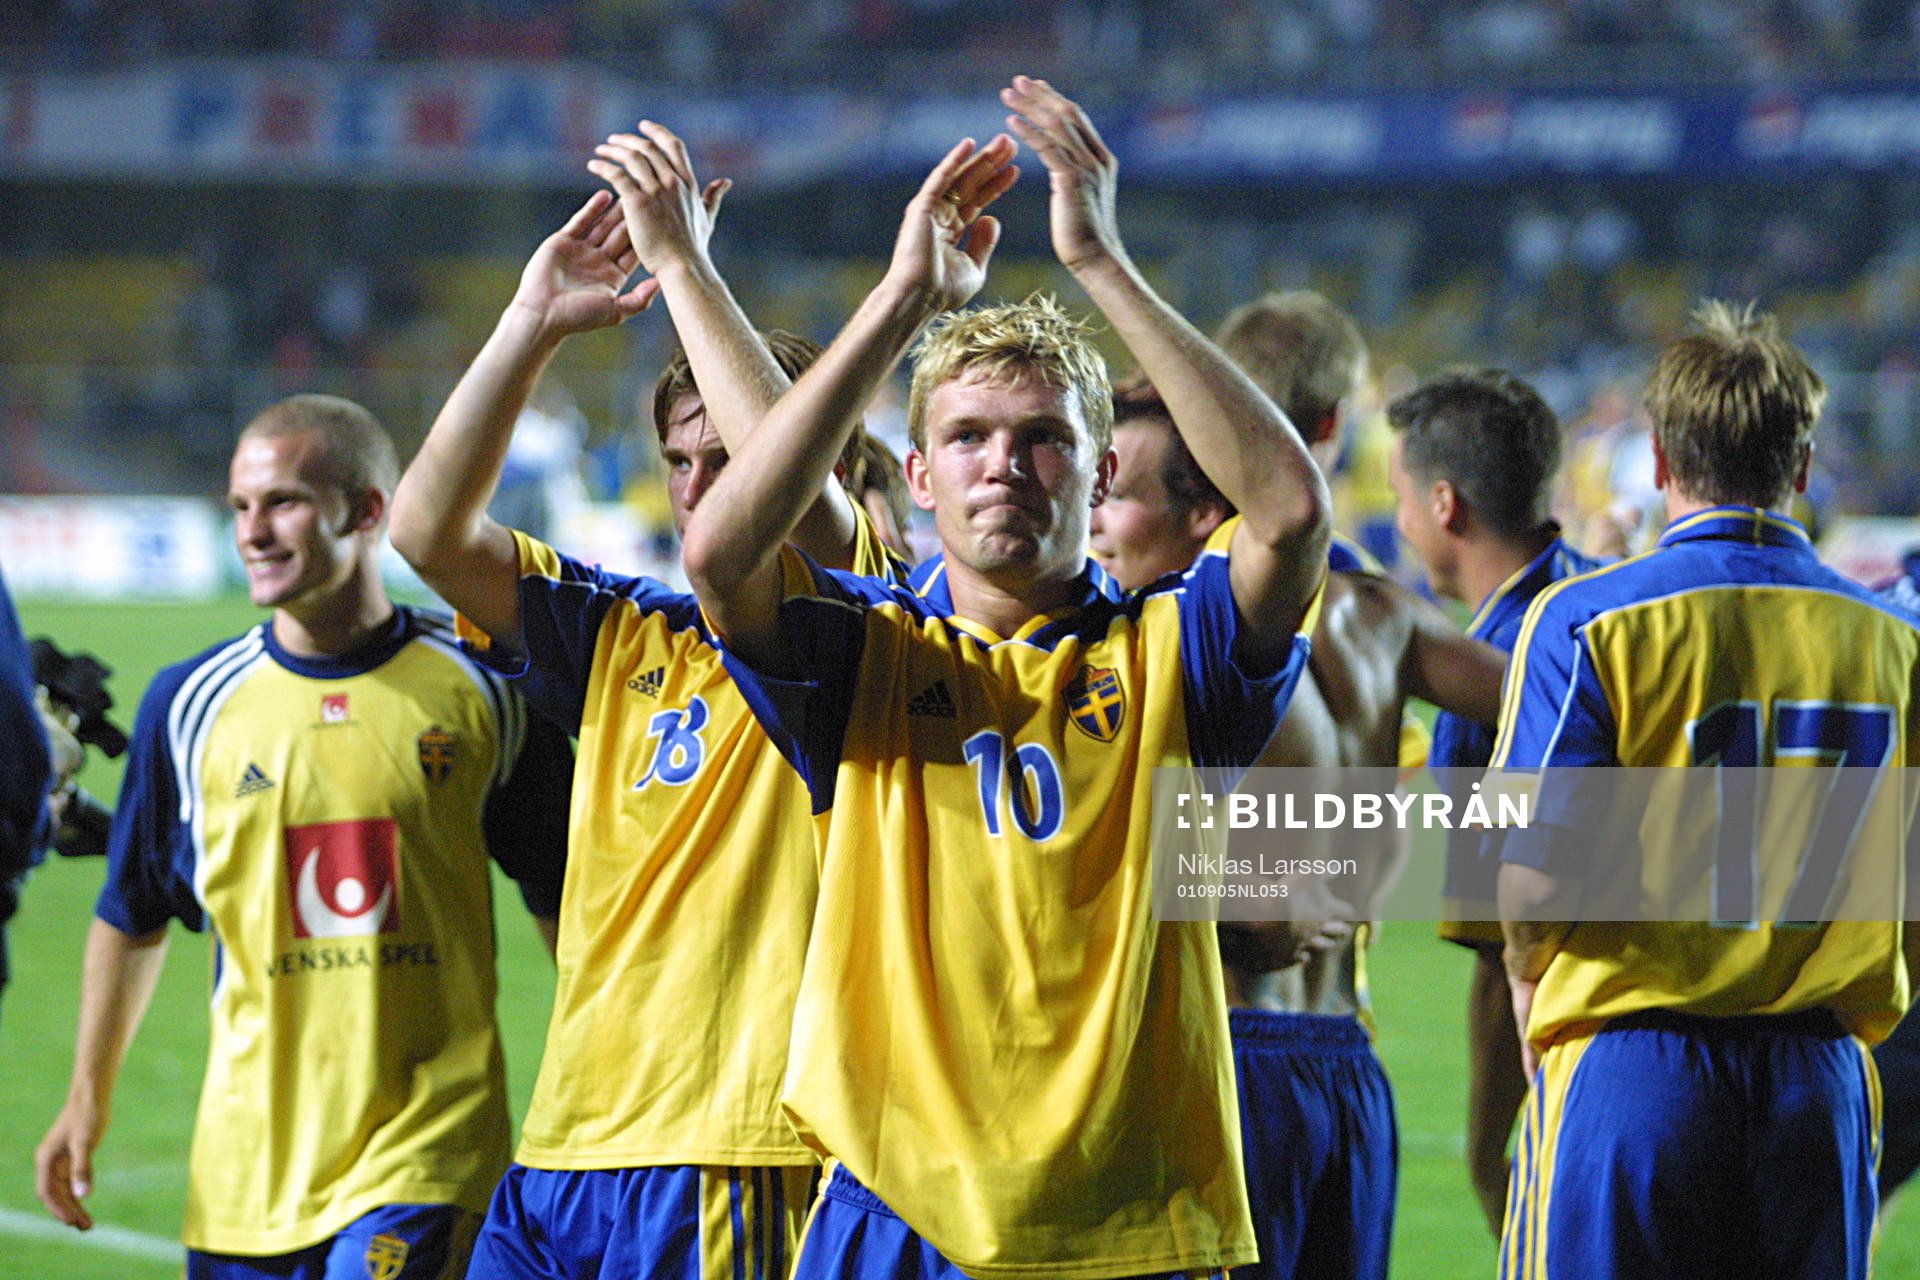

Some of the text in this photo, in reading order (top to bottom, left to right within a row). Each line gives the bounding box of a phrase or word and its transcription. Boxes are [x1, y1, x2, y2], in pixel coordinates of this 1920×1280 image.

[962, 730, 1065, 843] 10
[1684, 699, 1898, 931] 17
[383, 943, 438, 966] SPEL
